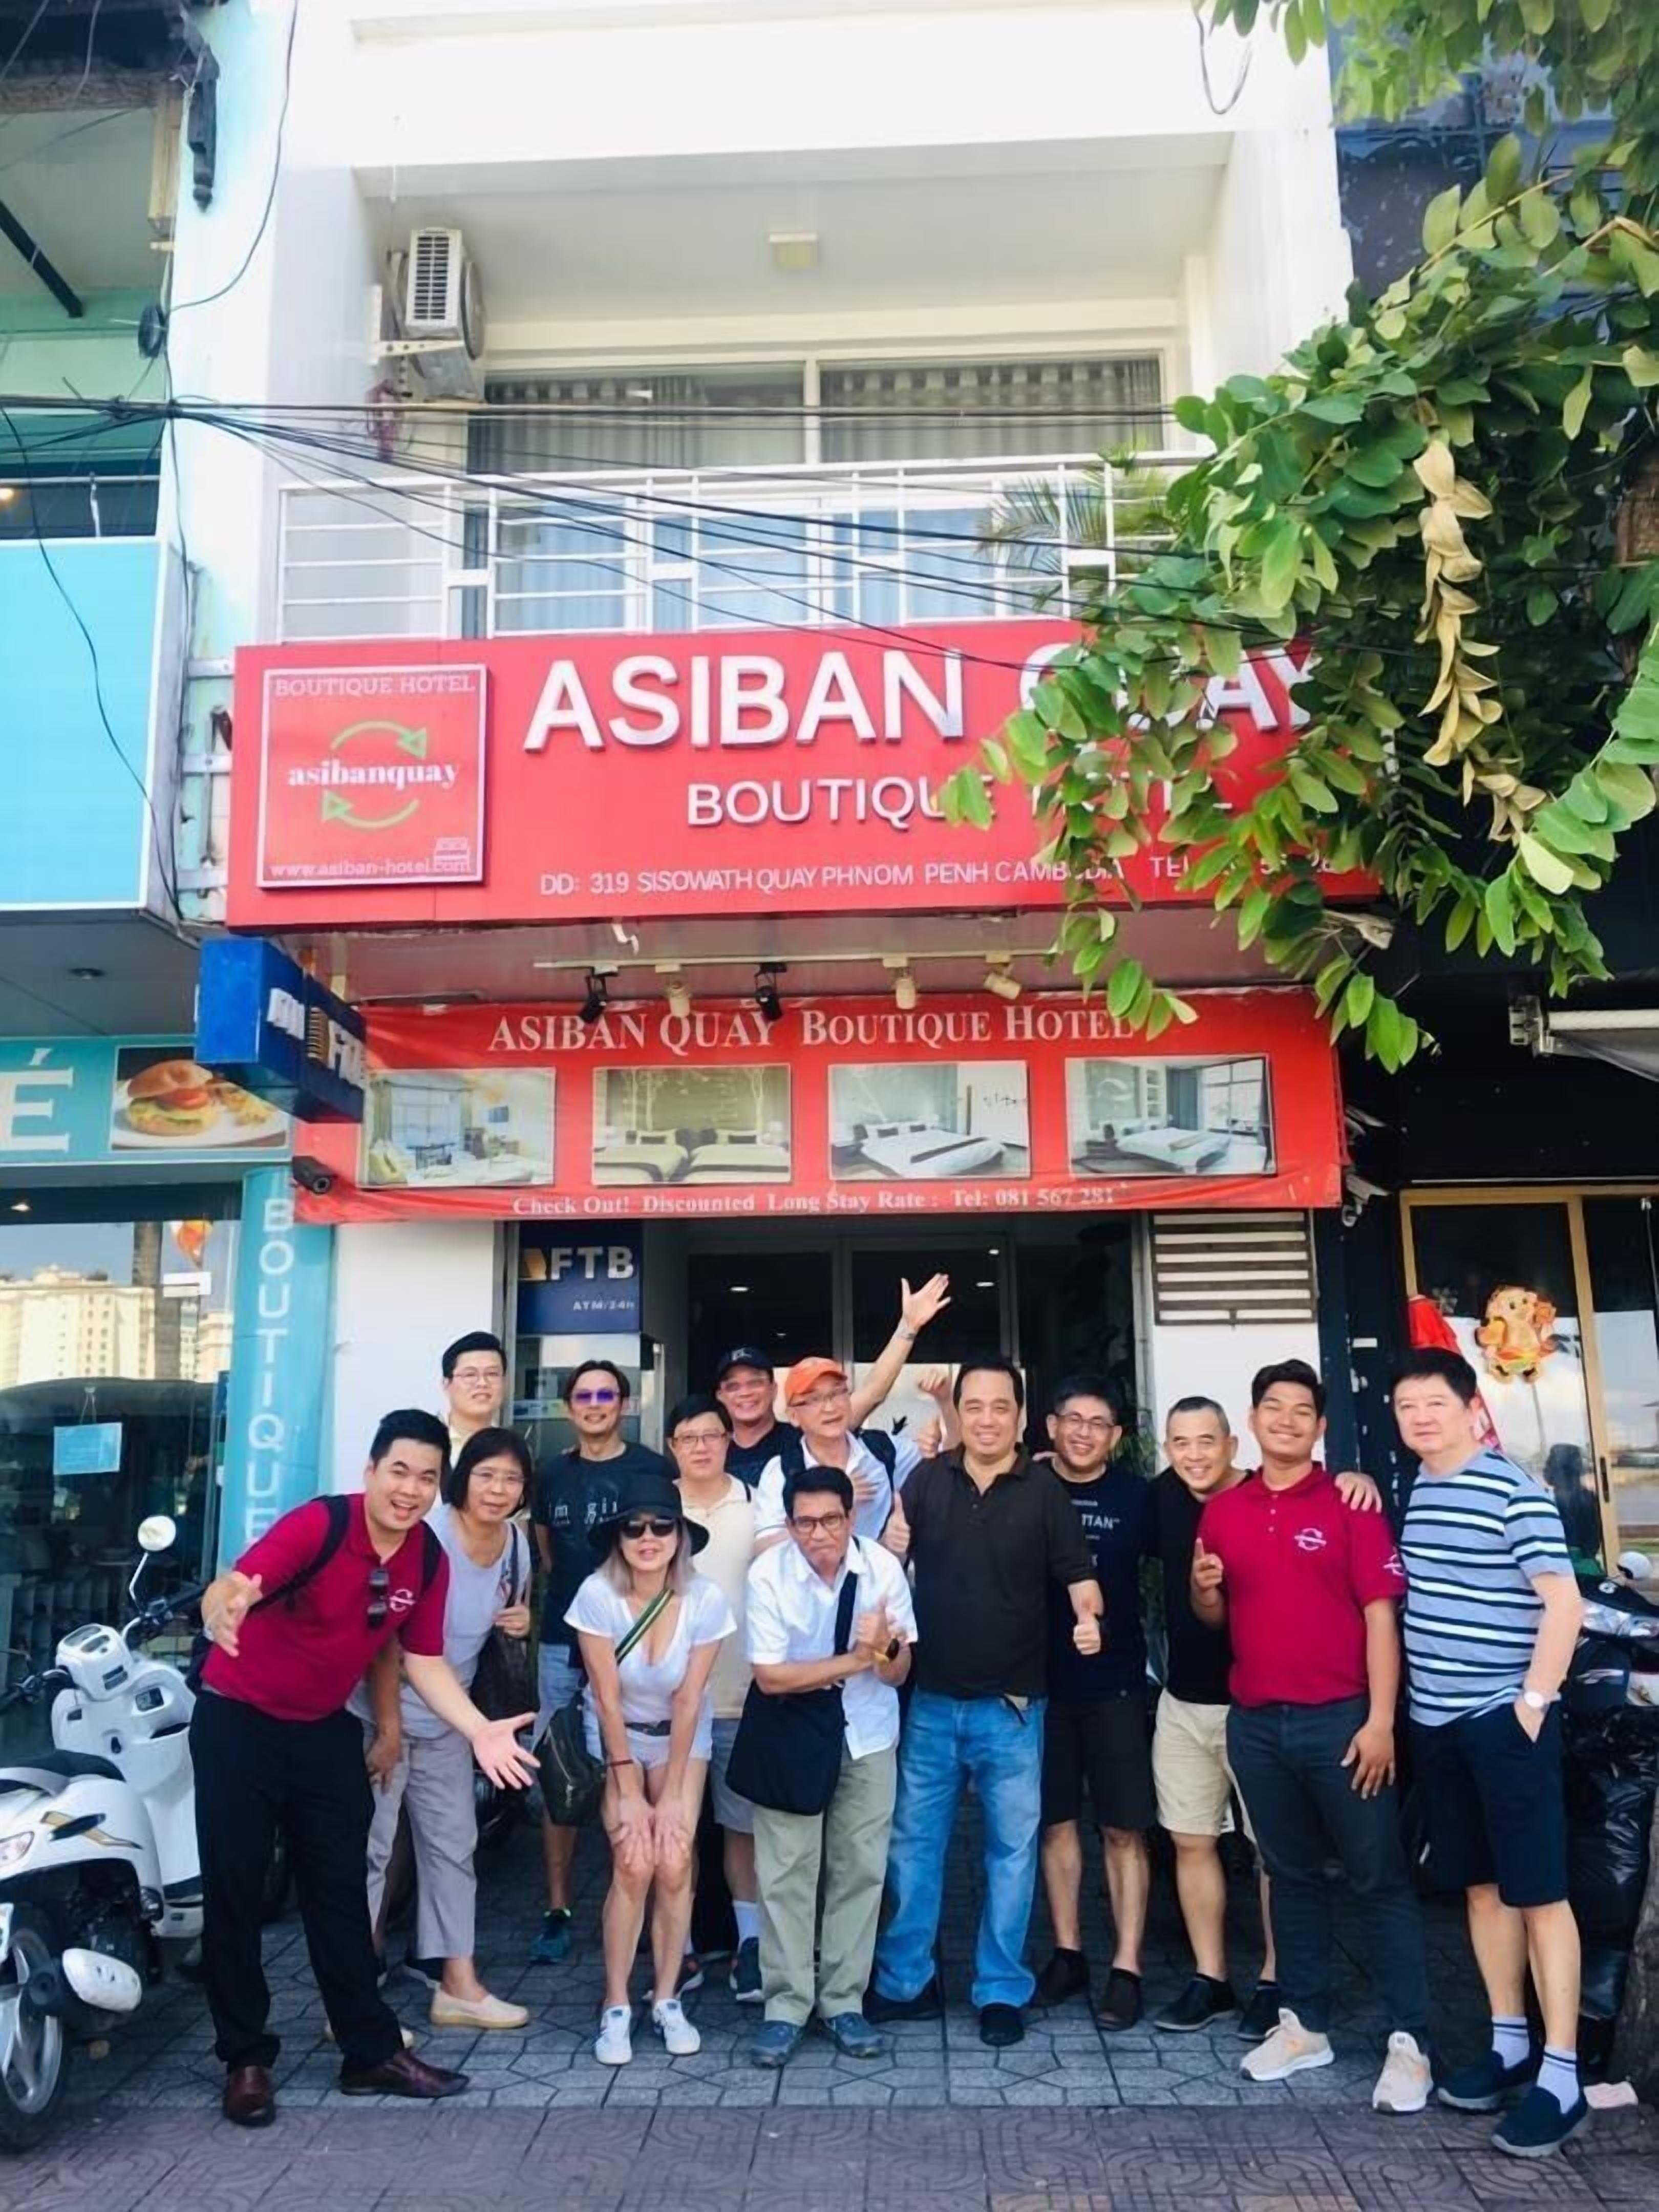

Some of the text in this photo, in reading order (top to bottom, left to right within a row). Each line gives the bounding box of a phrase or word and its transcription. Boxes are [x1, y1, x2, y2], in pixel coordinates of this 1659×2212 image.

[275, 674, 475, 697] BOUTIQUE HOTEL
[523, 650, 964, 752] ASIBAN
[288, 758, 459, 791] asibanquay
[688, 774, 995, 831] BOUTIQU
[590, 871, 630, 894] 319
[636, 869, 753, 894] SISOWATH
[756, 867, 818, 895] QUAY
[821, 864, 913, 887] PHNOM
[925, 861, 989, 885] PENH
[489, 1013, 646, 1051] ASIBAN
[660, 1011, 773, 1056] QUAY
[802, 1009, 991, 1048] BOUTIQUE
[513, 1196, 577, 1215] Check
[583, 1195, 630, 1215] Out!
[643, 1194, 754, 1214] Discounted
[767, 1193, 820, 1213] Long
[827, 1193, 871, 1213] Stay
[950, 1189, 989, 1207] Tel:
[995, 1187, 1029, 1206] 081
[550, 1245, 634, 1280] FTB
